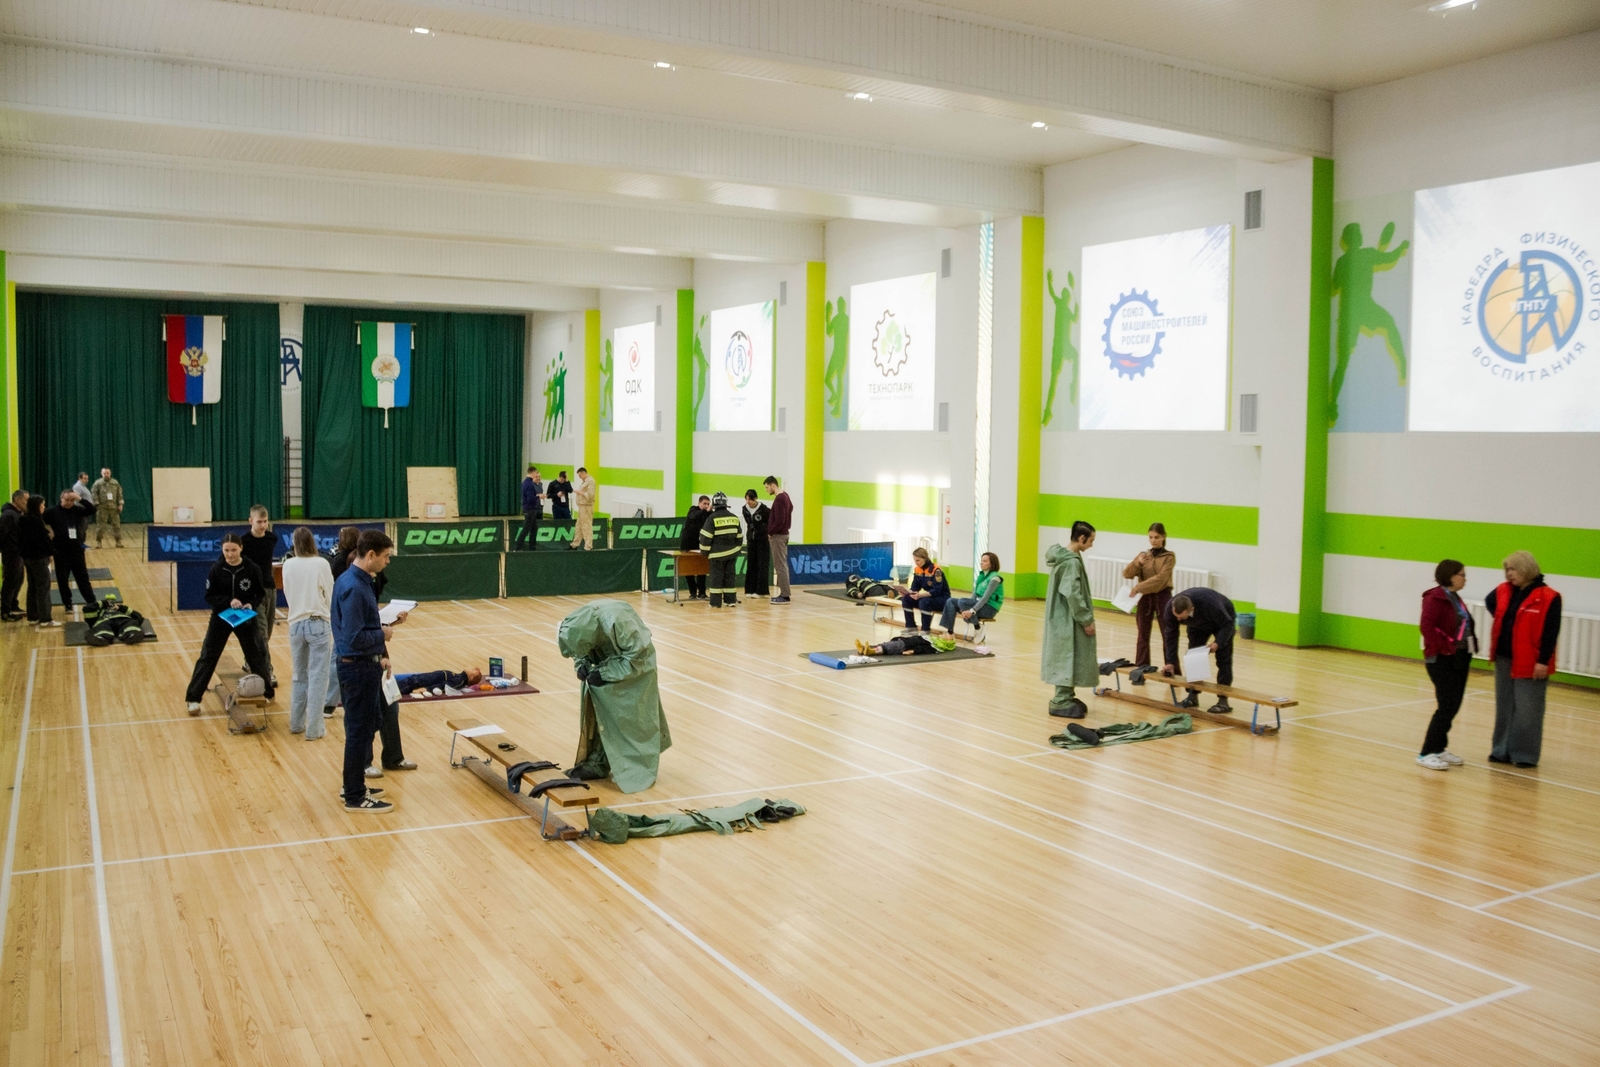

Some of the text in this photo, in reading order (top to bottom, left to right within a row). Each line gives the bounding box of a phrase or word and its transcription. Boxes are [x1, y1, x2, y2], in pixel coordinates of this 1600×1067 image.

[1461, 247, 1505, 326] КАФЕДРА
[1121, 306, 1144, 318] СОЮЗ
[1509, 298, 1550, 312] УГНТУ
[1121, 313, 1208, 332] МАШИНОСТРОИТЕЛЕЙ
[1121, 333, 1151, 346] РОССИИ
[1471, 341, 1587, 383] ВОСПИТАНИЯ
[625, 379, 643, 396] ОДК
[868, 382, 914, 394] ТЕХНОПАРК
[404, 527, 498, 546] DONIC
[619, 524, 684, 540] DONI
